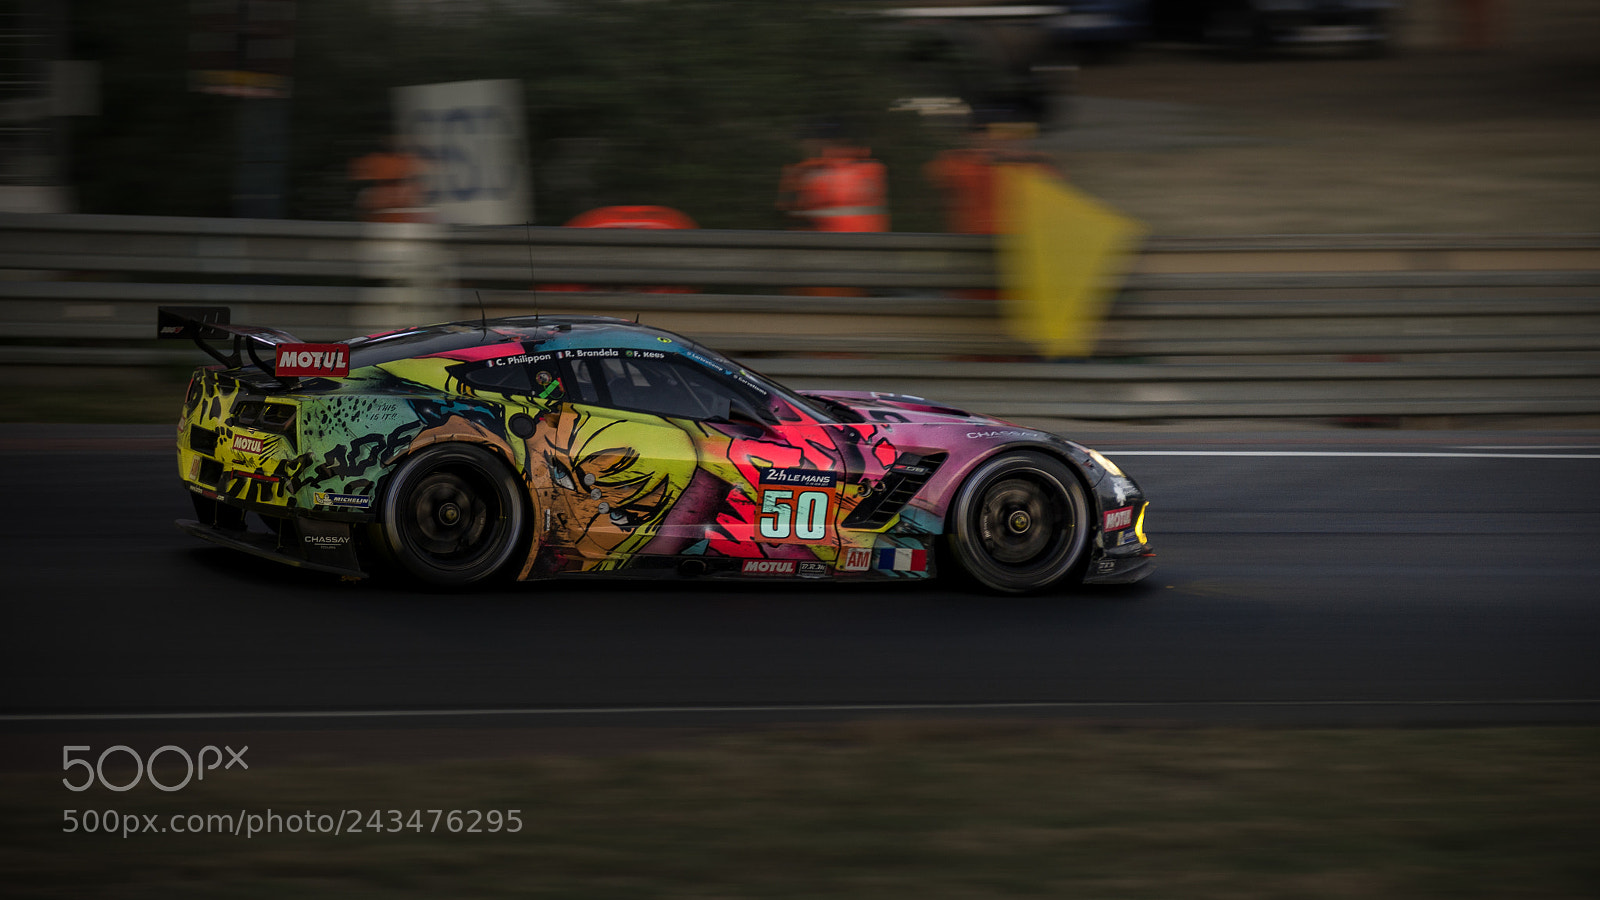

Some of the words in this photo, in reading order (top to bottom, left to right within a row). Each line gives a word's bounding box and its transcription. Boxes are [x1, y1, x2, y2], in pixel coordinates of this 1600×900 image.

[508, 353, 551, 365] Philippon
[565, 349, 575, 358] R.
[577, 348, 619, 358] Brandela
[279, 351, 347, 369] MOTUL
[234, 436, 262, 452] MOTUL
[801, 475, 831, 483] MANS
[760, 489, 829, 540] 50
[1105, 509, 1132, 530] MOTUL
[304, 535, 350, 543] CHASSAY
[847, 552, 870, 567] AM
[744, 561, 794, 572] MOTUL
